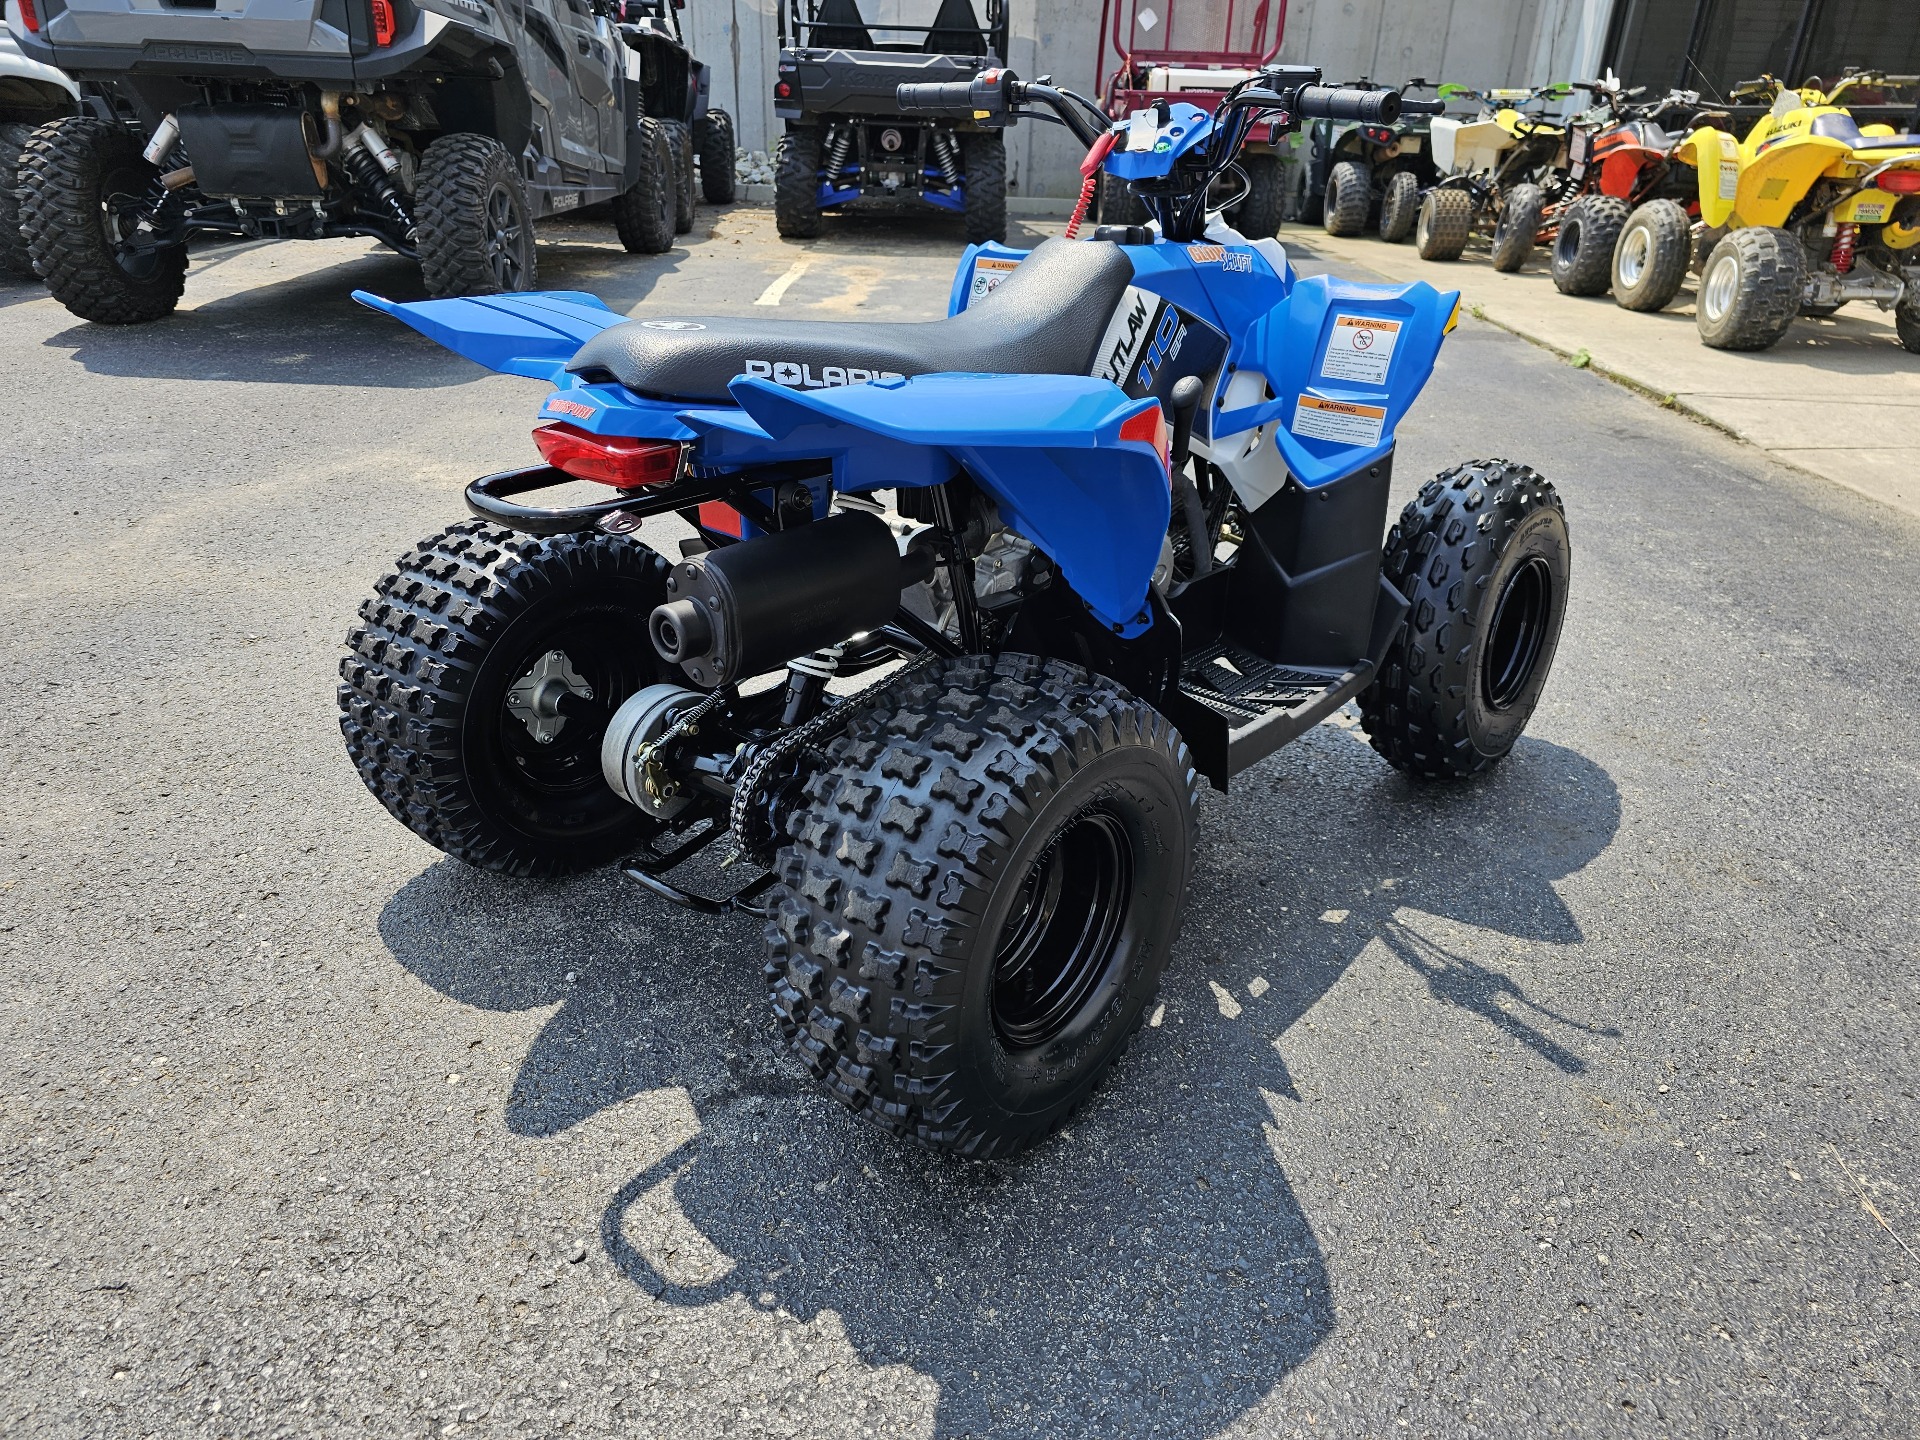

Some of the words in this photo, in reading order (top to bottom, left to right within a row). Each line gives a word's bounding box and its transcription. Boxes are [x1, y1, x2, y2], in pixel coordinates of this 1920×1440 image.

[154, 47, 245, 62] POLARIS
[1765, 120, 1802, 138] SUZUKI
[1220, 253, 1252, 273] SHIFT
[1354, 320, 1387, 329] WARNING
[1102, 291, 1147, 383] UTLAW
[1137, 303, 1180, 391] 110
[1170, 323, 1187, 361] EFI
[745, 360, 902, 387] POLAR
[1324, 403, 1356, 413] WARNING
